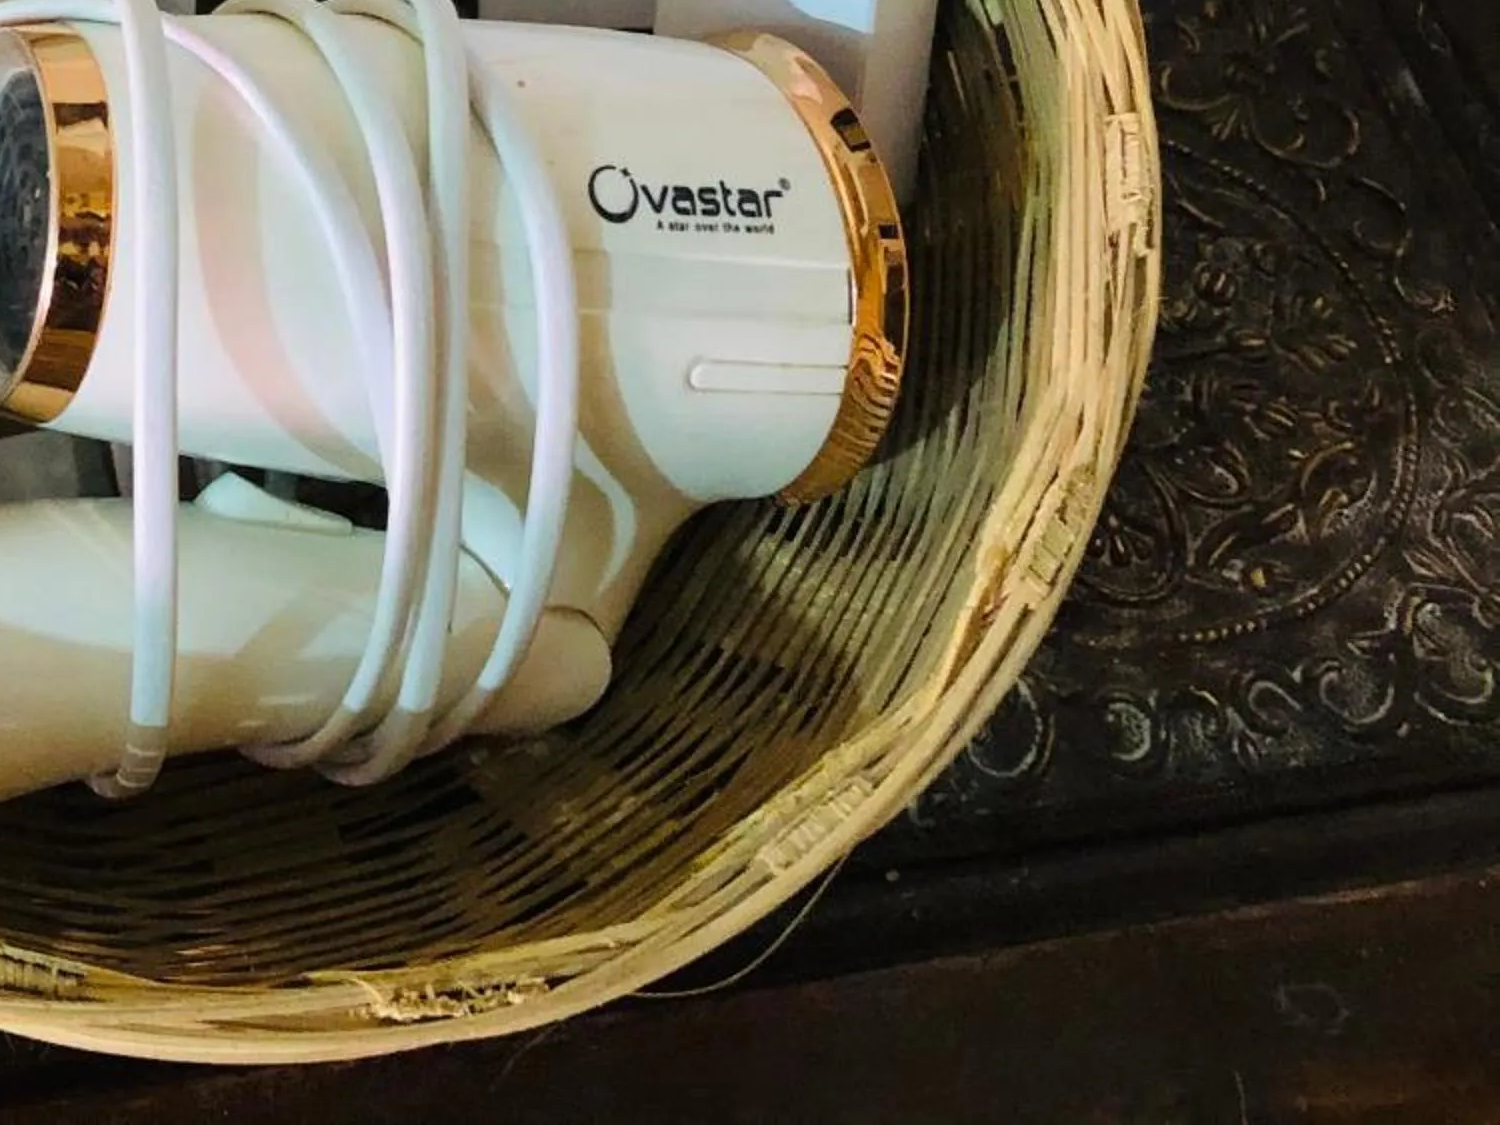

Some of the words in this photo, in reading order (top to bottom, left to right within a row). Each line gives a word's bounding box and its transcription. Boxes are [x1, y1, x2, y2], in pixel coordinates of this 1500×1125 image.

[656, 220, 663, 230] A
[668, 222, 689, 232] star
[695, 222, 719, 232] over
[722, 222, 740, 233] the
[745, 224, 775, 235] world
